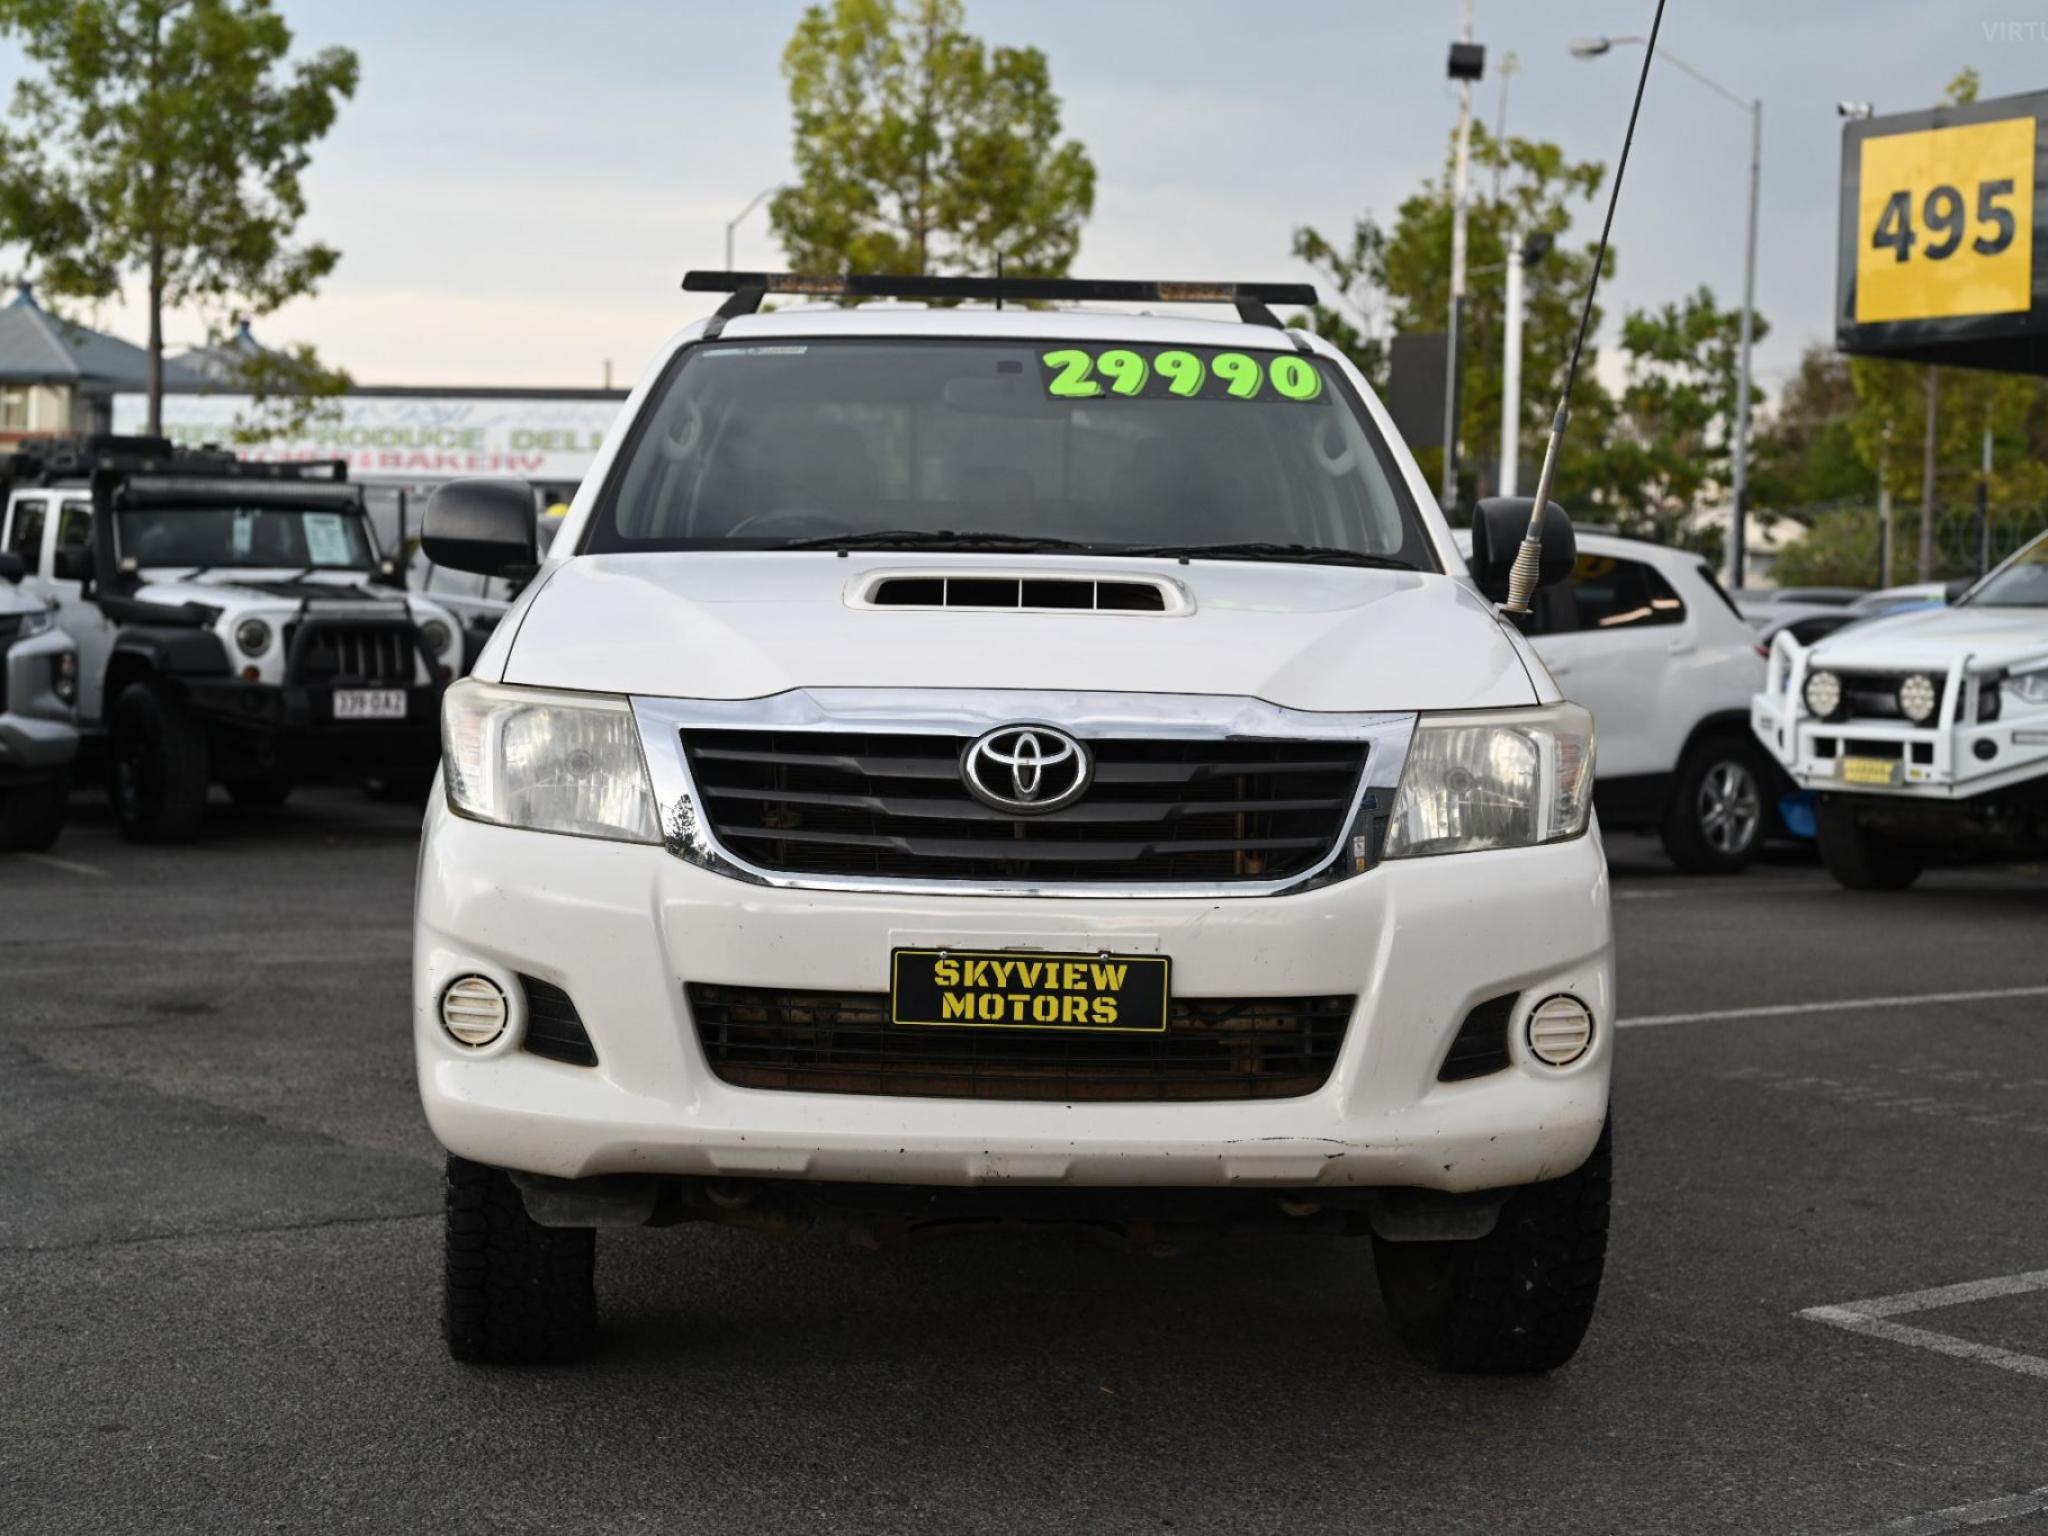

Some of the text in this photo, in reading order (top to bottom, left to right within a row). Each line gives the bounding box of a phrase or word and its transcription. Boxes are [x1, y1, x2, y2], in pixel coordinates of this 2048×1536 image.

[1873, 178, 2015, 263] 495
[1042, 349, 1322, 400] 29990
[378, 453, 545, 471] BAKERY
[934, 959, 1128, 991] SKYVIEW
[942, 992, 1118, 1023] MOTORS
